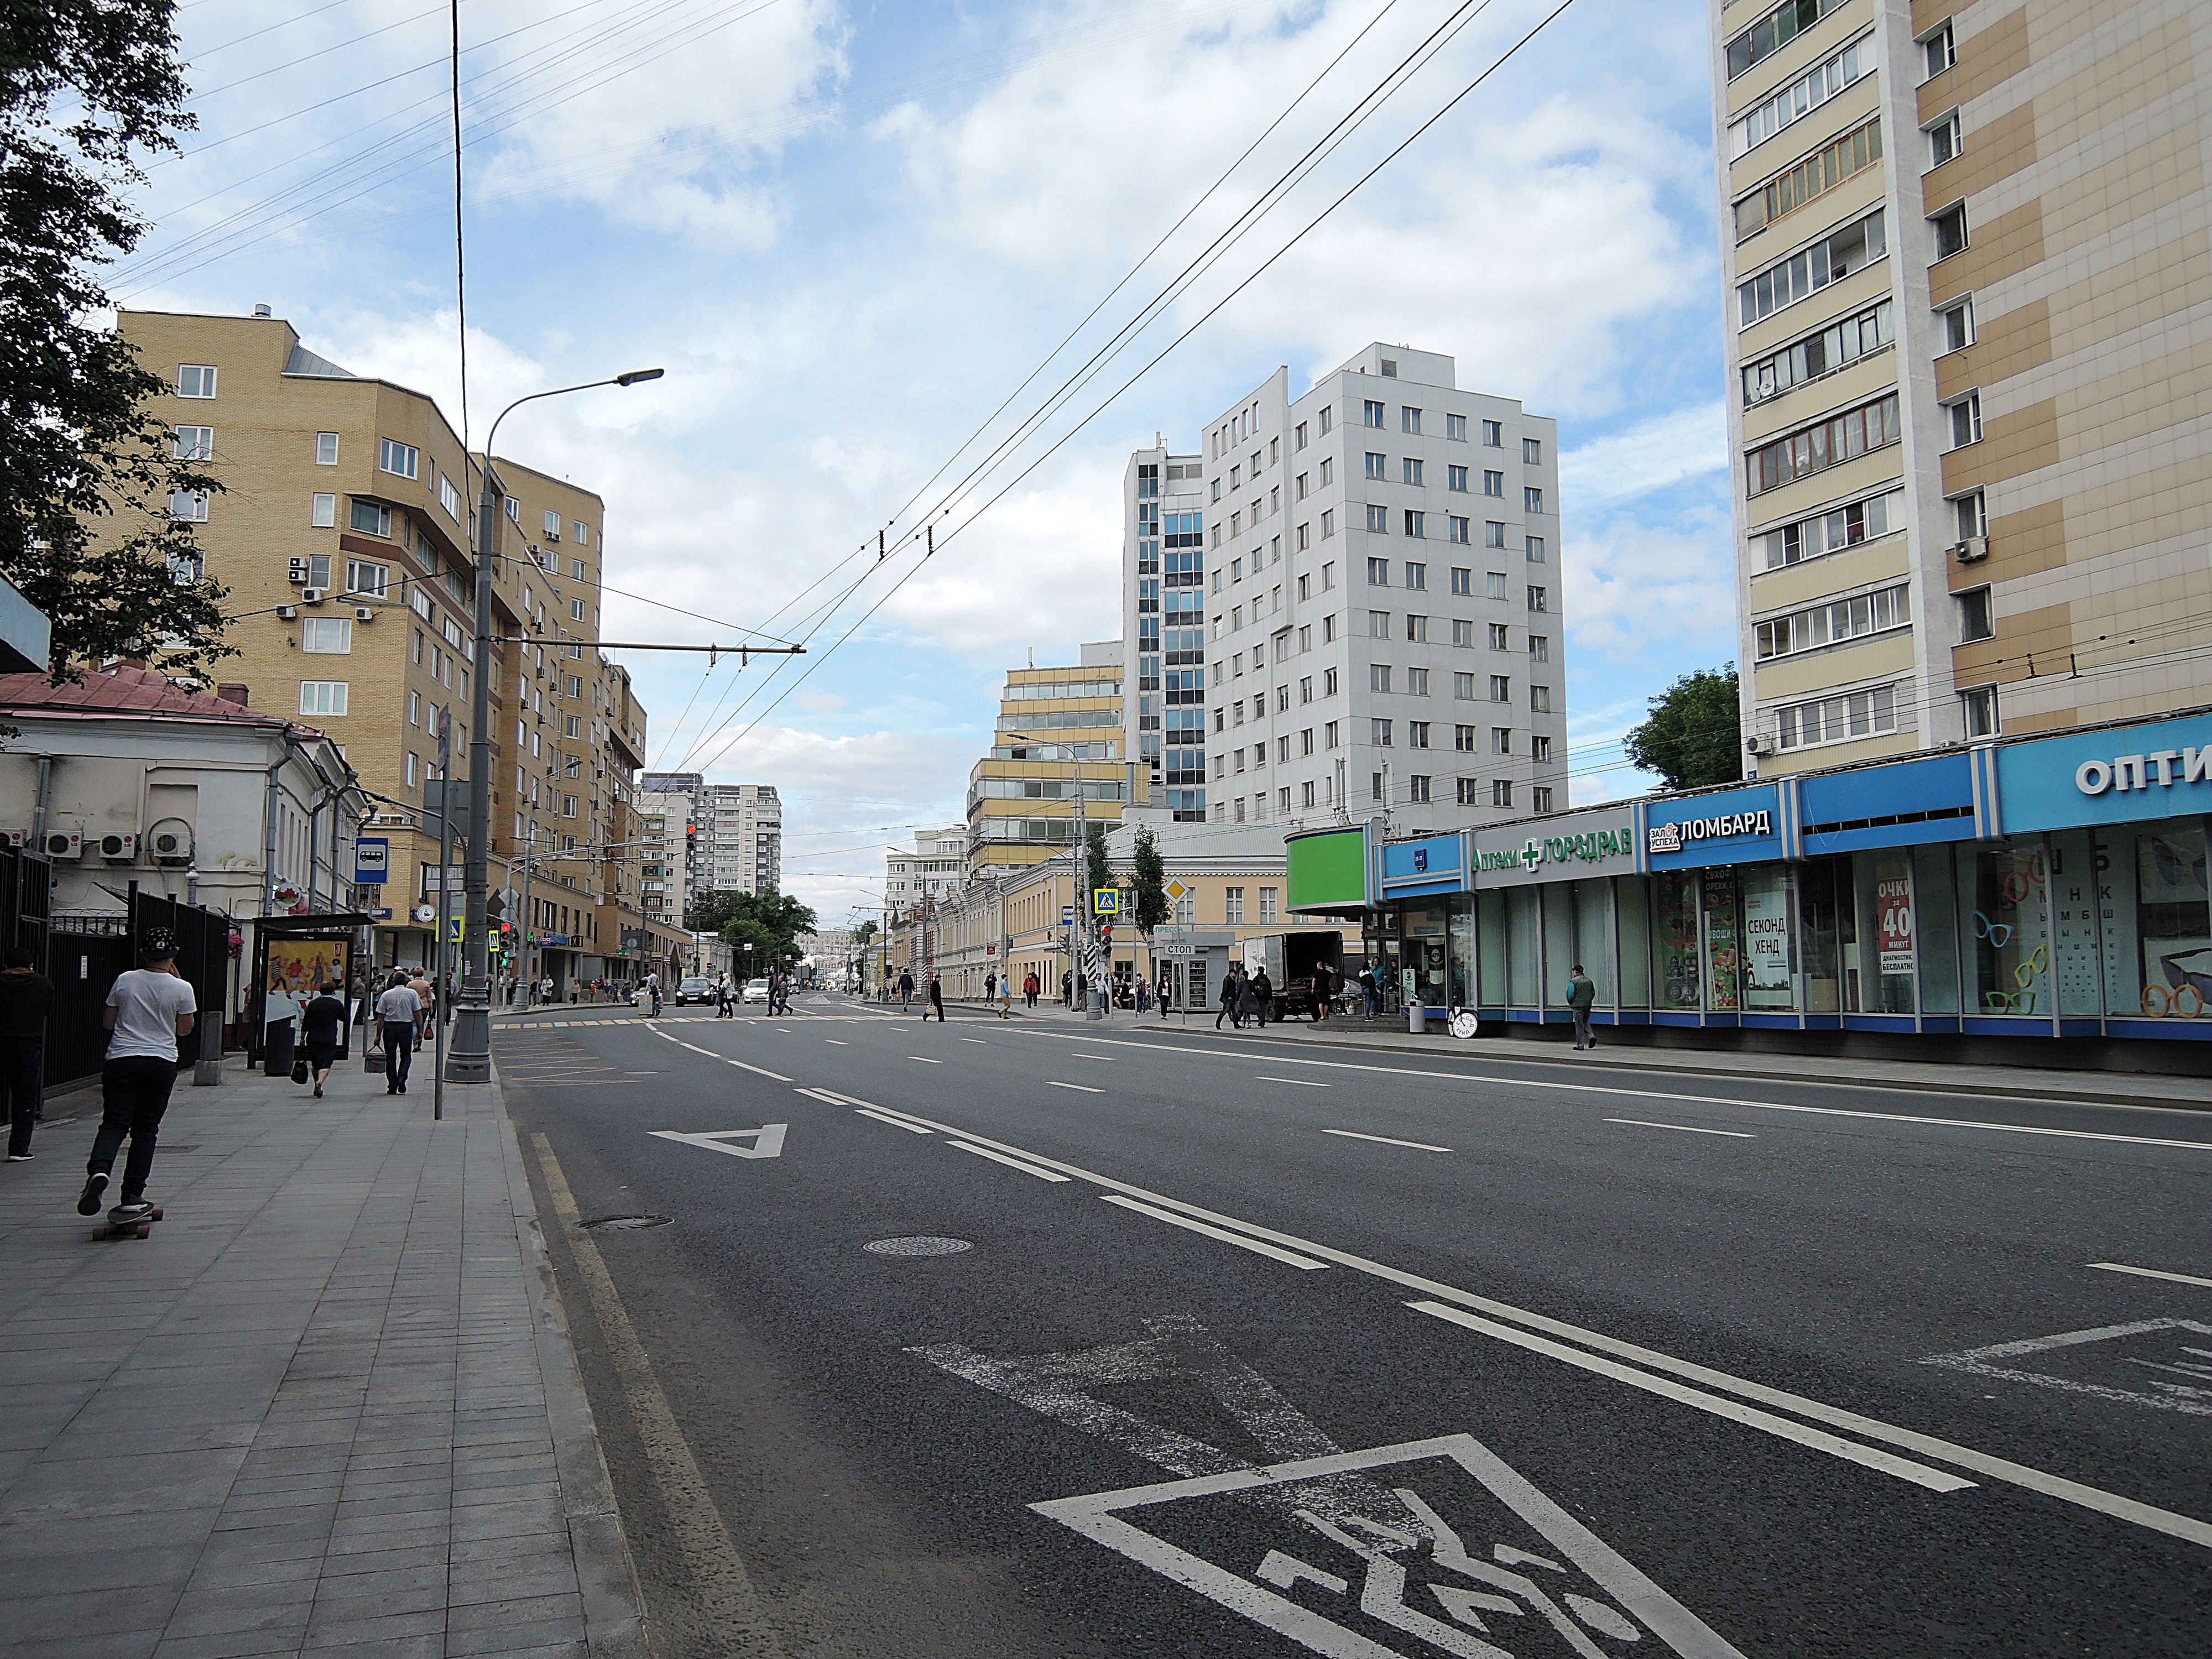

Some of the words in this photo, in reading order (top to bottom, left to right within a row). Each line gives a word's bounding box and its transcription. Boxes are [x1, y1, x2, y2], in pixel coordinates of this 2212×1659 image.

[1681, 810, 1770, 841] ЛОМБАРД
[1472, 849, 1520, 871] Аптеки
[1543, 828, 1632, 862] ГОРЗДРАВ
[1651, 838, 1678, 847] УСПЕХА
[2100, 885, 2112, 899] К
[1883, 907, 1911, 938] 40
[2060, 911, 2070, 921] М
[2081, 910, 2090, 920] Б
[2103, 909, 2114, 919] Ш
[1748, 918, 1786, 936] СЕКОНД
[1168, 945, 1191, 953] СТОП
[1755, 939, 1780, 957] ХЕНД
[1888, 940, 1909, 949] МИНУТ
